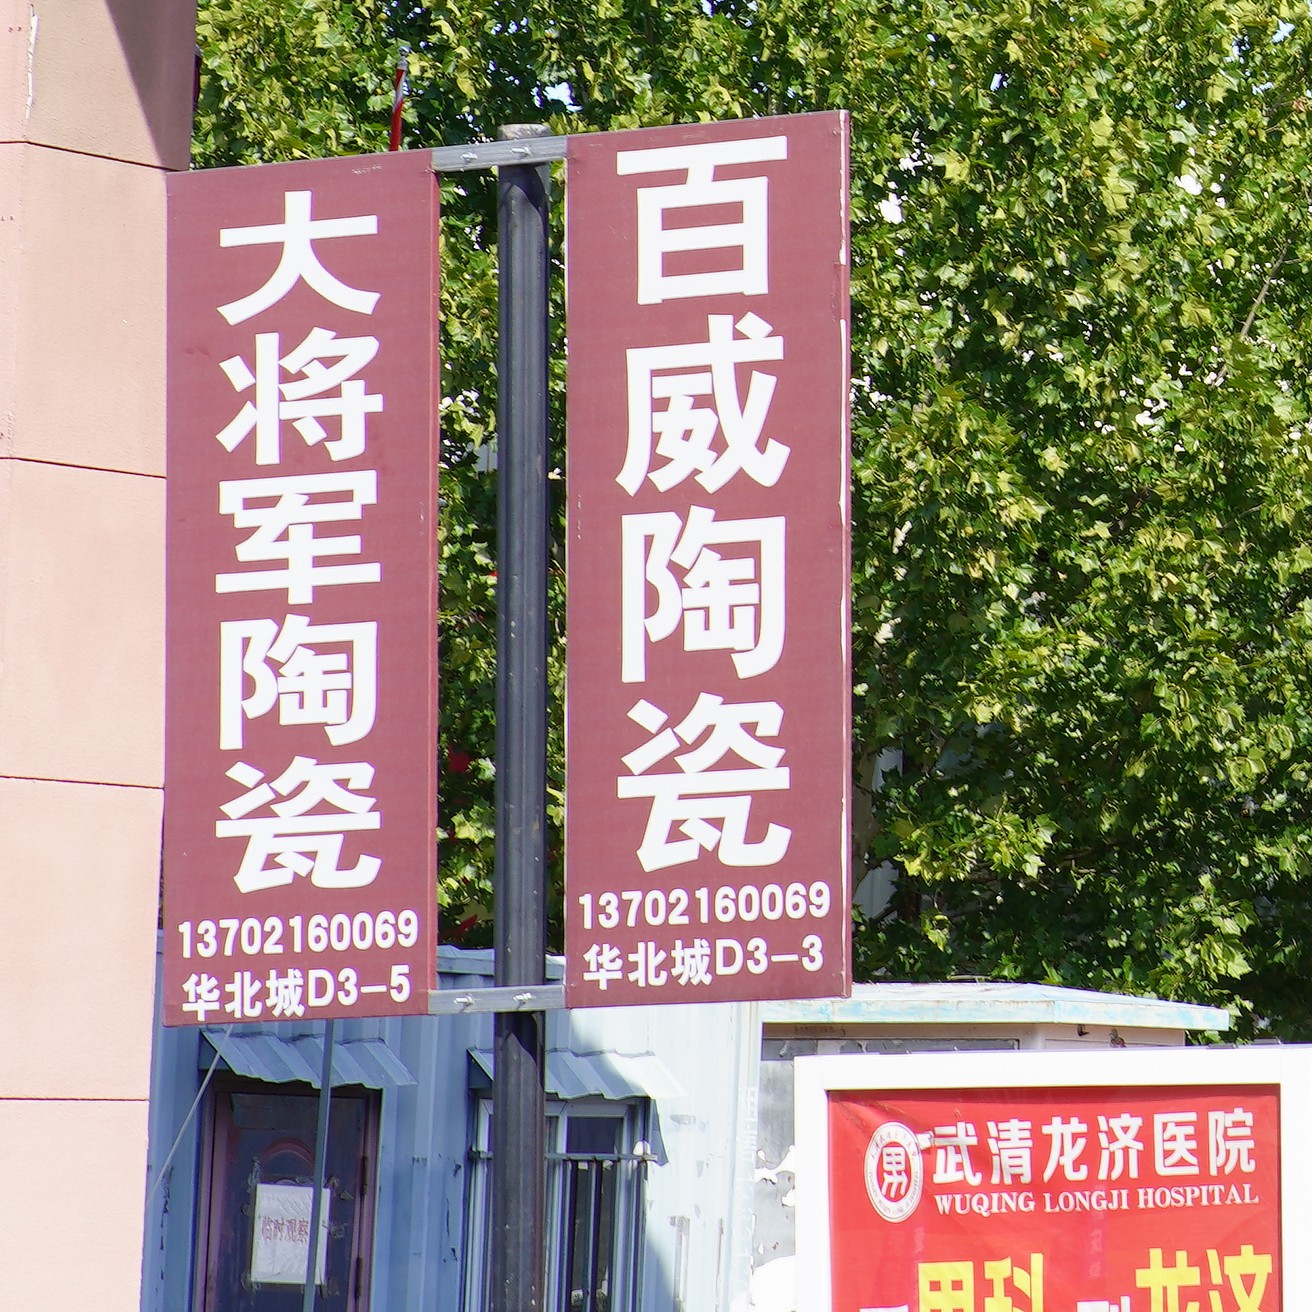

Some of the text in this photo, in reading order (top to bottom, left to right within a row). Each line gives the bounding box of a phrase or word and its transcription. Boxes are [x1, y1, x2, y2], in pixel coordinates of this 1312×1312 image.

[615, 135, 793, 873] 百威陶瓷
[215, 189, 384, 894] 大将军陶瓷
[577, 878, 832, 931] 13702160069
[177, 909, 420, 960] 13702160069
[582, 934, 825, 987] 华北城D3-3
[181, 961, 412, 1021] 华北城D3-5
[932, 1107, 1257, 1186] 武清龙济医院
[934, 1190, 1036, 1218] WUQING
[1043, 1187, 1130, 1214] LONGJI
[1137, 1183, 1259, 1210] HOSPITAL
